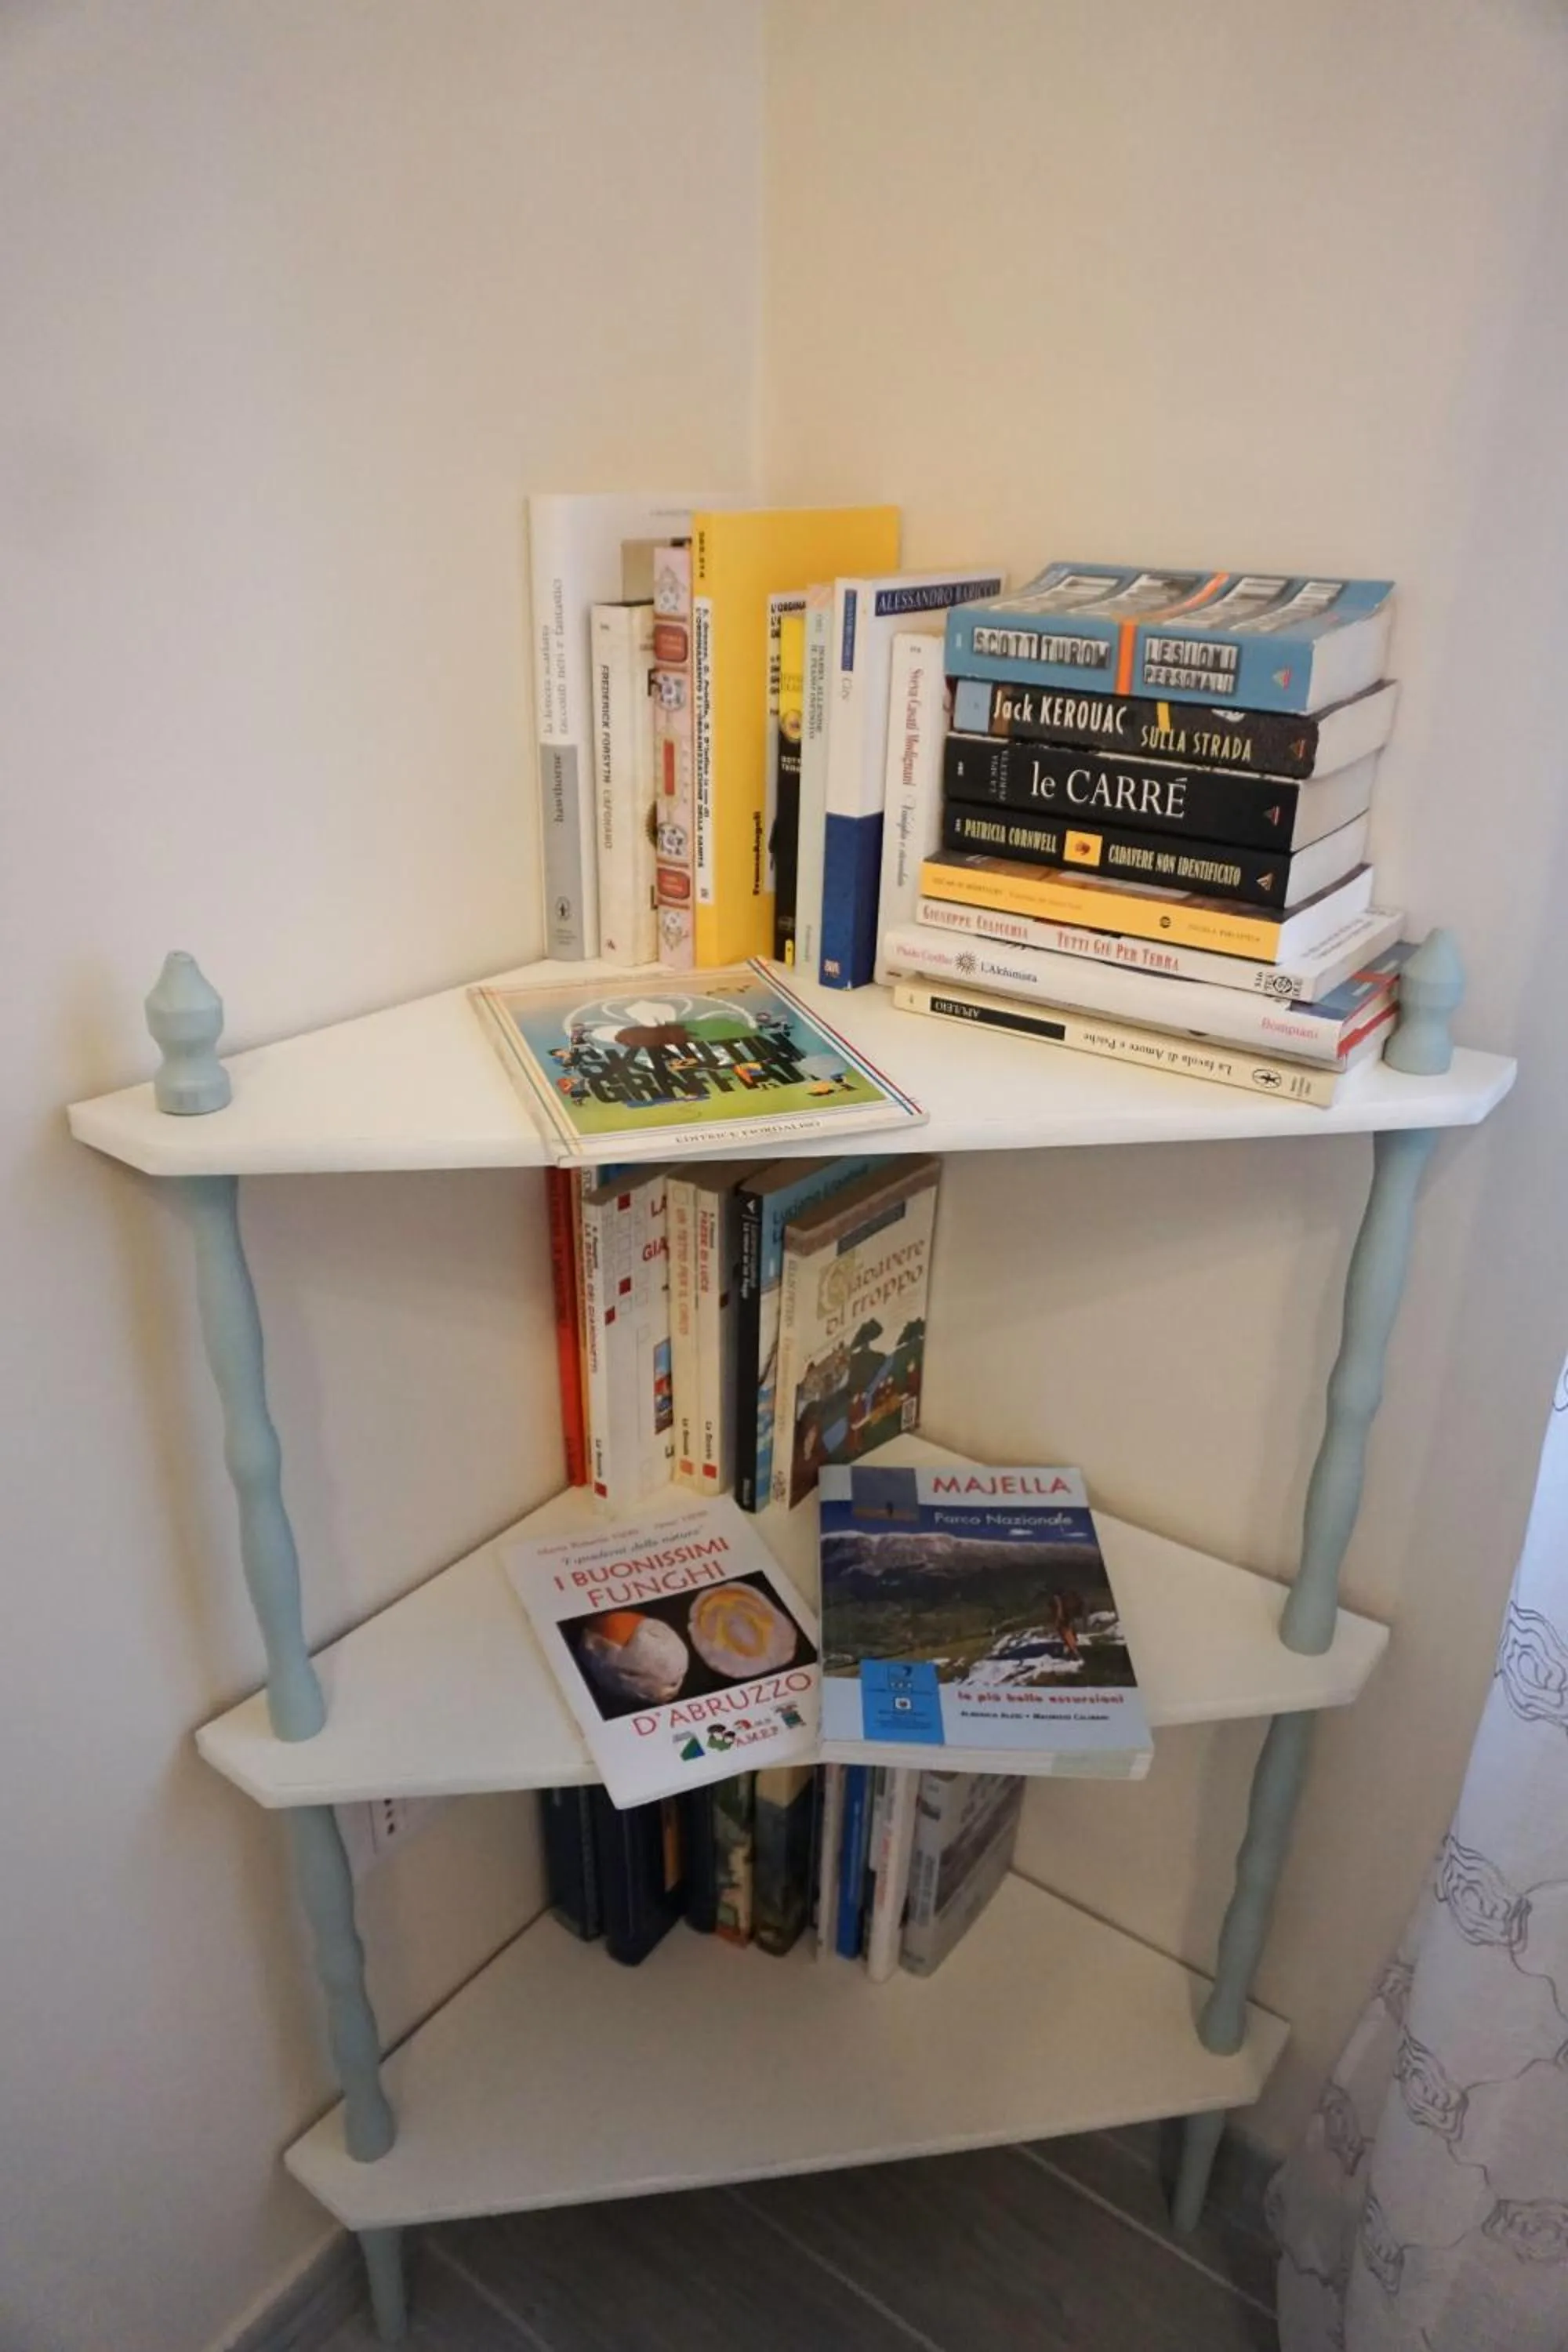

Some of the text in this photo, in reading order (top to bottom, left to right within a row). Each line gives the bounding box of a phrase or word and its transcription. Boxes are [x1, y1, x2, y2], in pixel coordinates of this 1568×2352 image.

[878, 588, 953, 612] ALESSANDRO
[975, 629, 1037, 659] SCOTT
[1040, 635, 1110, 666] TUROW
[1146, 638, 1239, 670] LESIONI
[600, 665, 610, 729] FREDERICK
[907, 668, 924, 697] Sveva
[1143, 665, 1235, 694] PERSONALI
[993, 688, 1127, 735] Jack KEROUAC
[601, 732, 612, 783] FORSYTH
[902, 734, 920, 786] Modignani
[1140, 724, 1253, 761] SULLA STRADA
[1029, 760, 1189, 819] le CARRÉ
[964, 818, 1007, 844] PATRICIA
[1007, 826, 1058, 854] CORNWELL
[1108, 844, 1242, 888] CADAVERE NON IDENTIFICATO
[932, 1475, 1073, 1496] MAJELLA
[933, 1512, 1073, 1526] Parco Nazionale
[554, 1537, 731, 1592] I BUONISSIMI
[586, 1559, 726, 1608] FUNGHI
